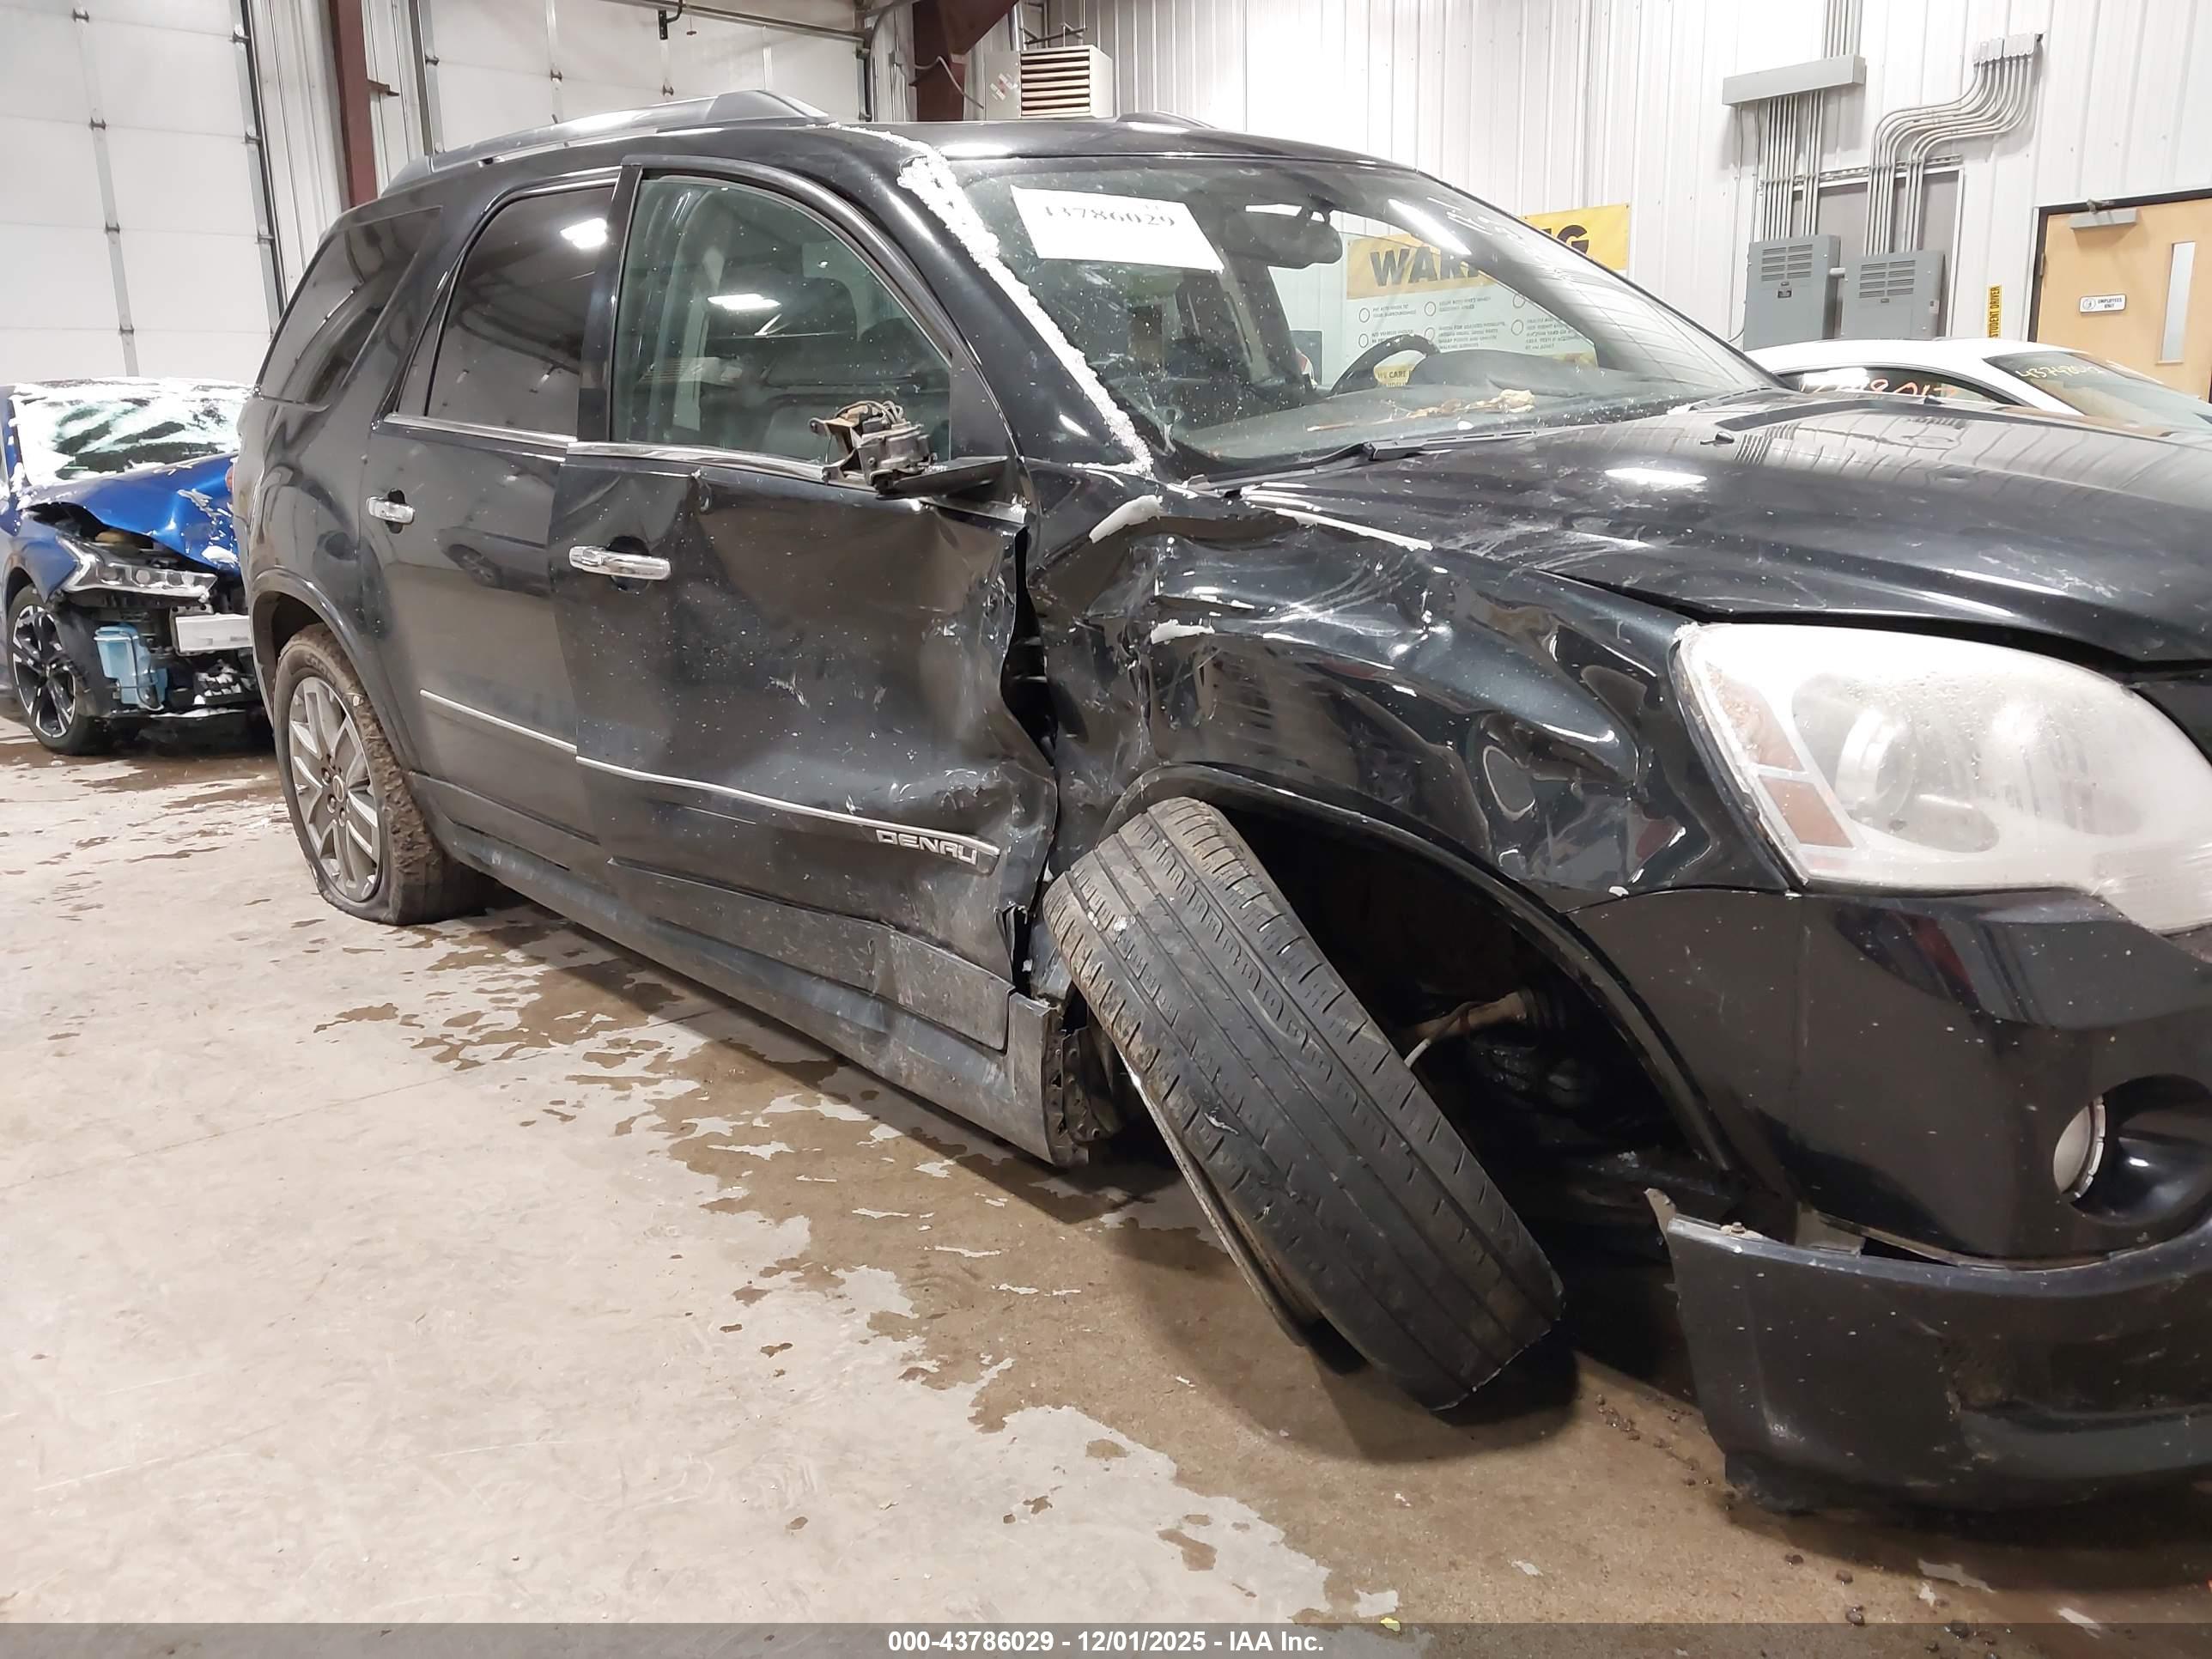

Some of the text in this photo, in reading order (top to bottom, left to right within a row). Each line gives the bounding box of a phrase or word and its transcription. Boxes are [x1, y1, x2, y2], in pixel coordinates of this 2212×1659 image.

[1989, 286, 2000, 338] STUDENT DRIVER
[876, 829, 978, 866] DENALI
